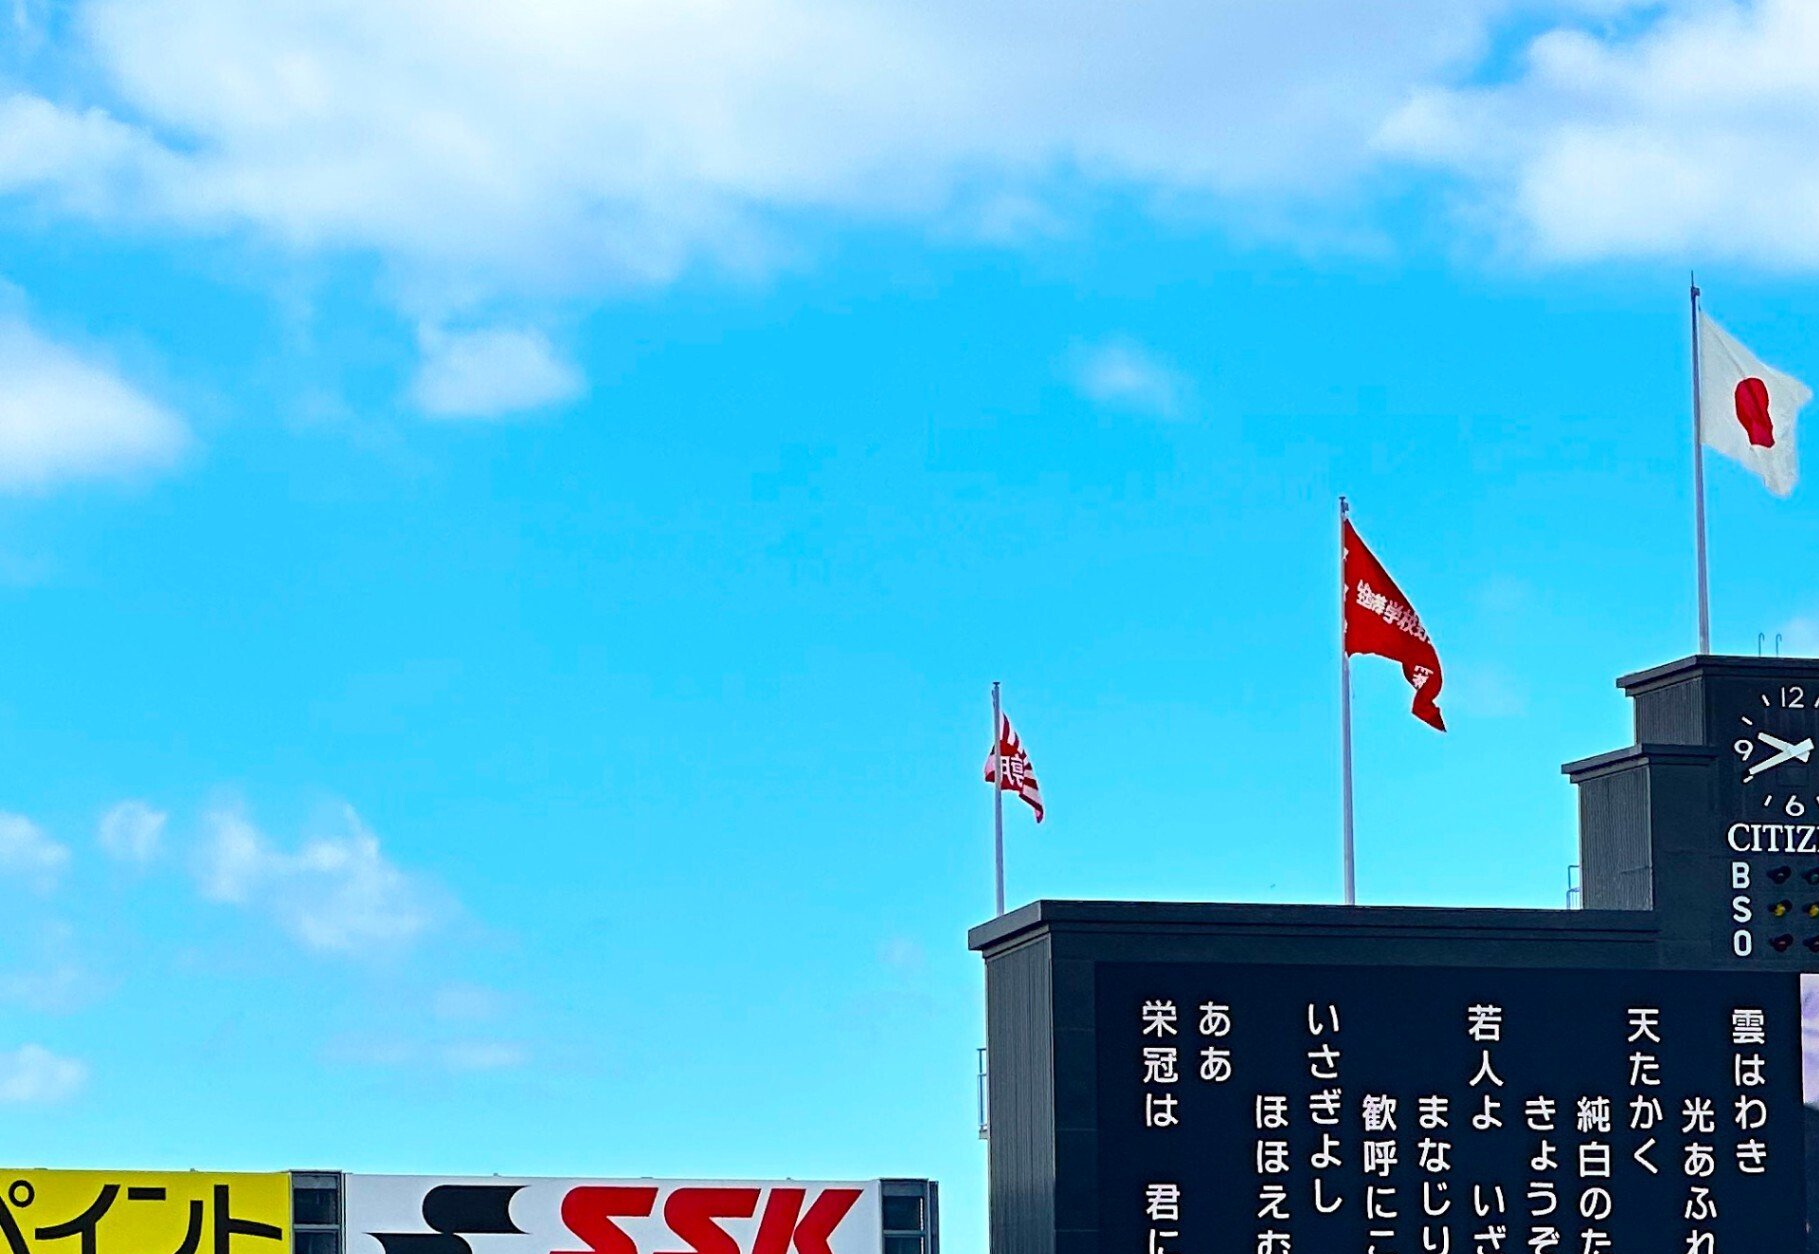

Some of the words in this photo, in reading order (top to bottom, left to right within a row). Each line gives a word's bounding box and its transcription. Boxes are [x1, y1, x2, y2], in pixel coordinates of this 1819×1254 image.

[1782, 687, 1804, 708] 12
[1734, 740, 1753, 760] 9
[1786, 795, 1804, 816] 6
[1733, 862, 1750, 888] B
[1733, 896, 1751, 922] S
[1143, 1000, 1178, 1126] 栄冠は
[1200, 1002, 1231, 1081] ああ
[1469, 1004, 1503, 1129] 若人よ
[1308, 1004, 1342, 1212] いさぎよし
[1628, 1009, 1663, 1173] 天たかく
[1733, 1010, 1766, 1172] 雲はわき
